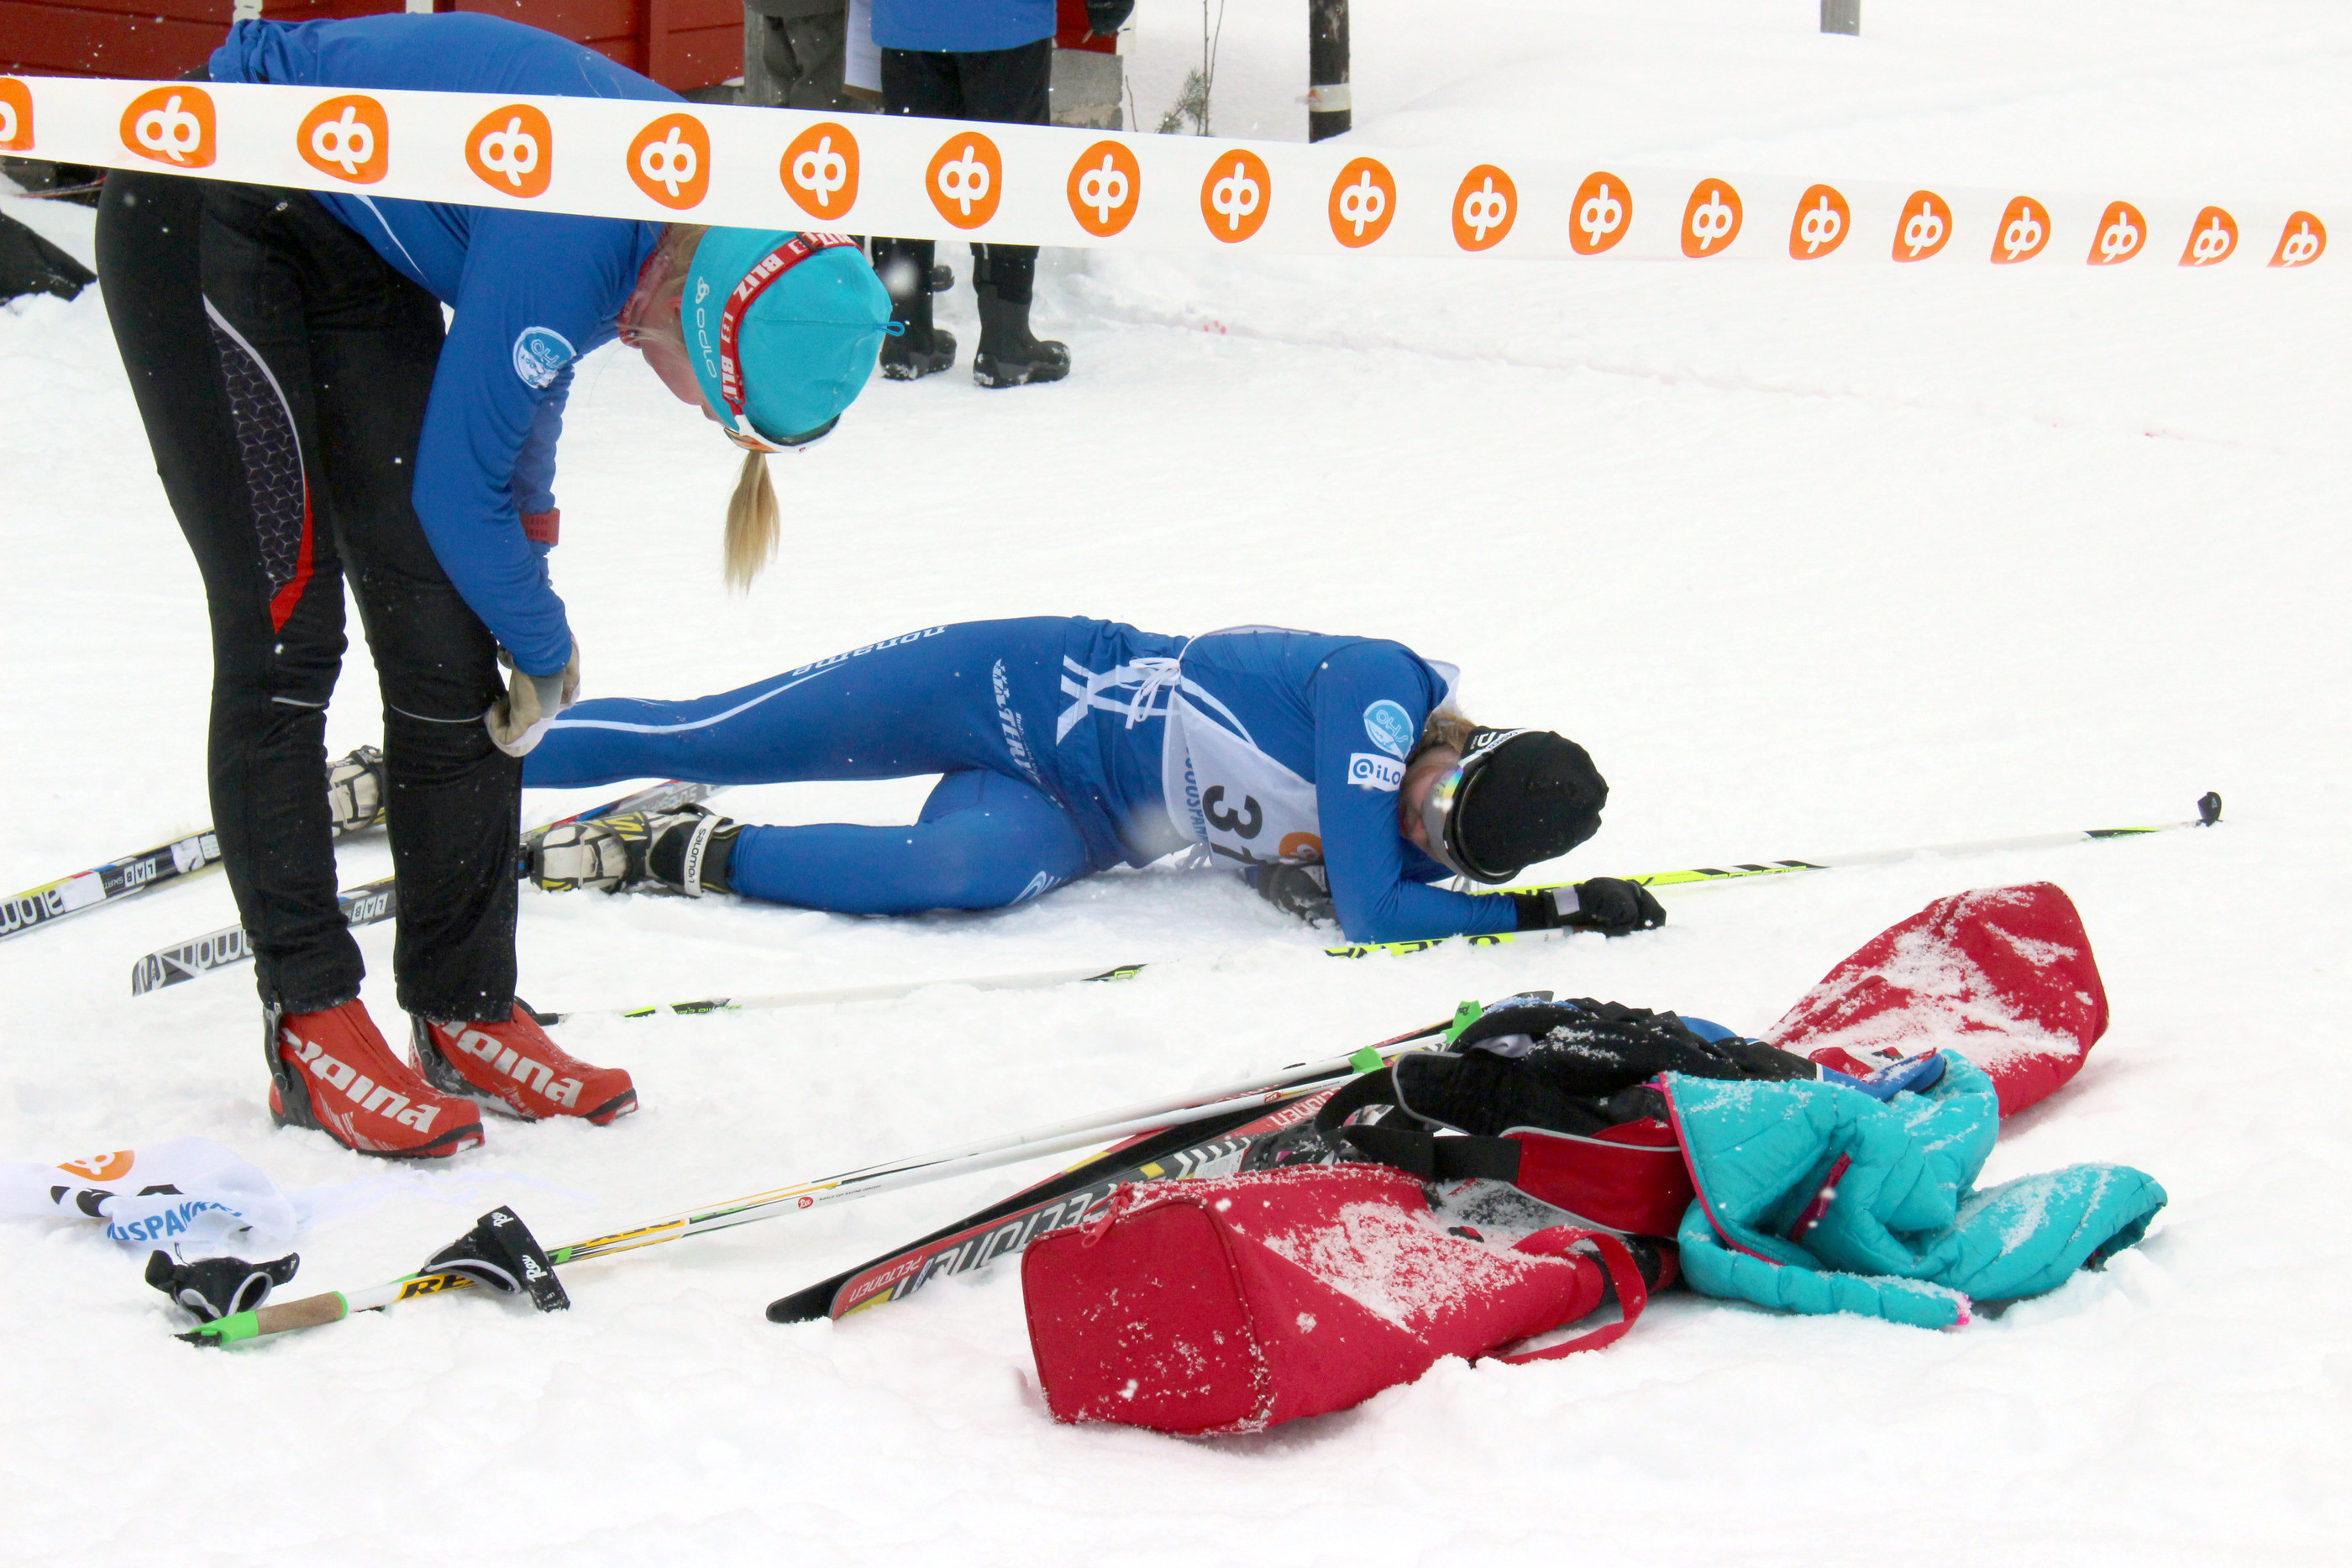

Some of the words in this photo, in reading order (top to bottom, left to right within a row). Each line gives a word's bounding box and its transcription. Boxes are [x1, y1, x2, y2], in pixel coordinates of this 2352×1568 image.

[732, 253, 785, 302] BLIZ
[401, 1273, 476, 1300] RE
[848, 1255, 923, 1303] PELTONEN
